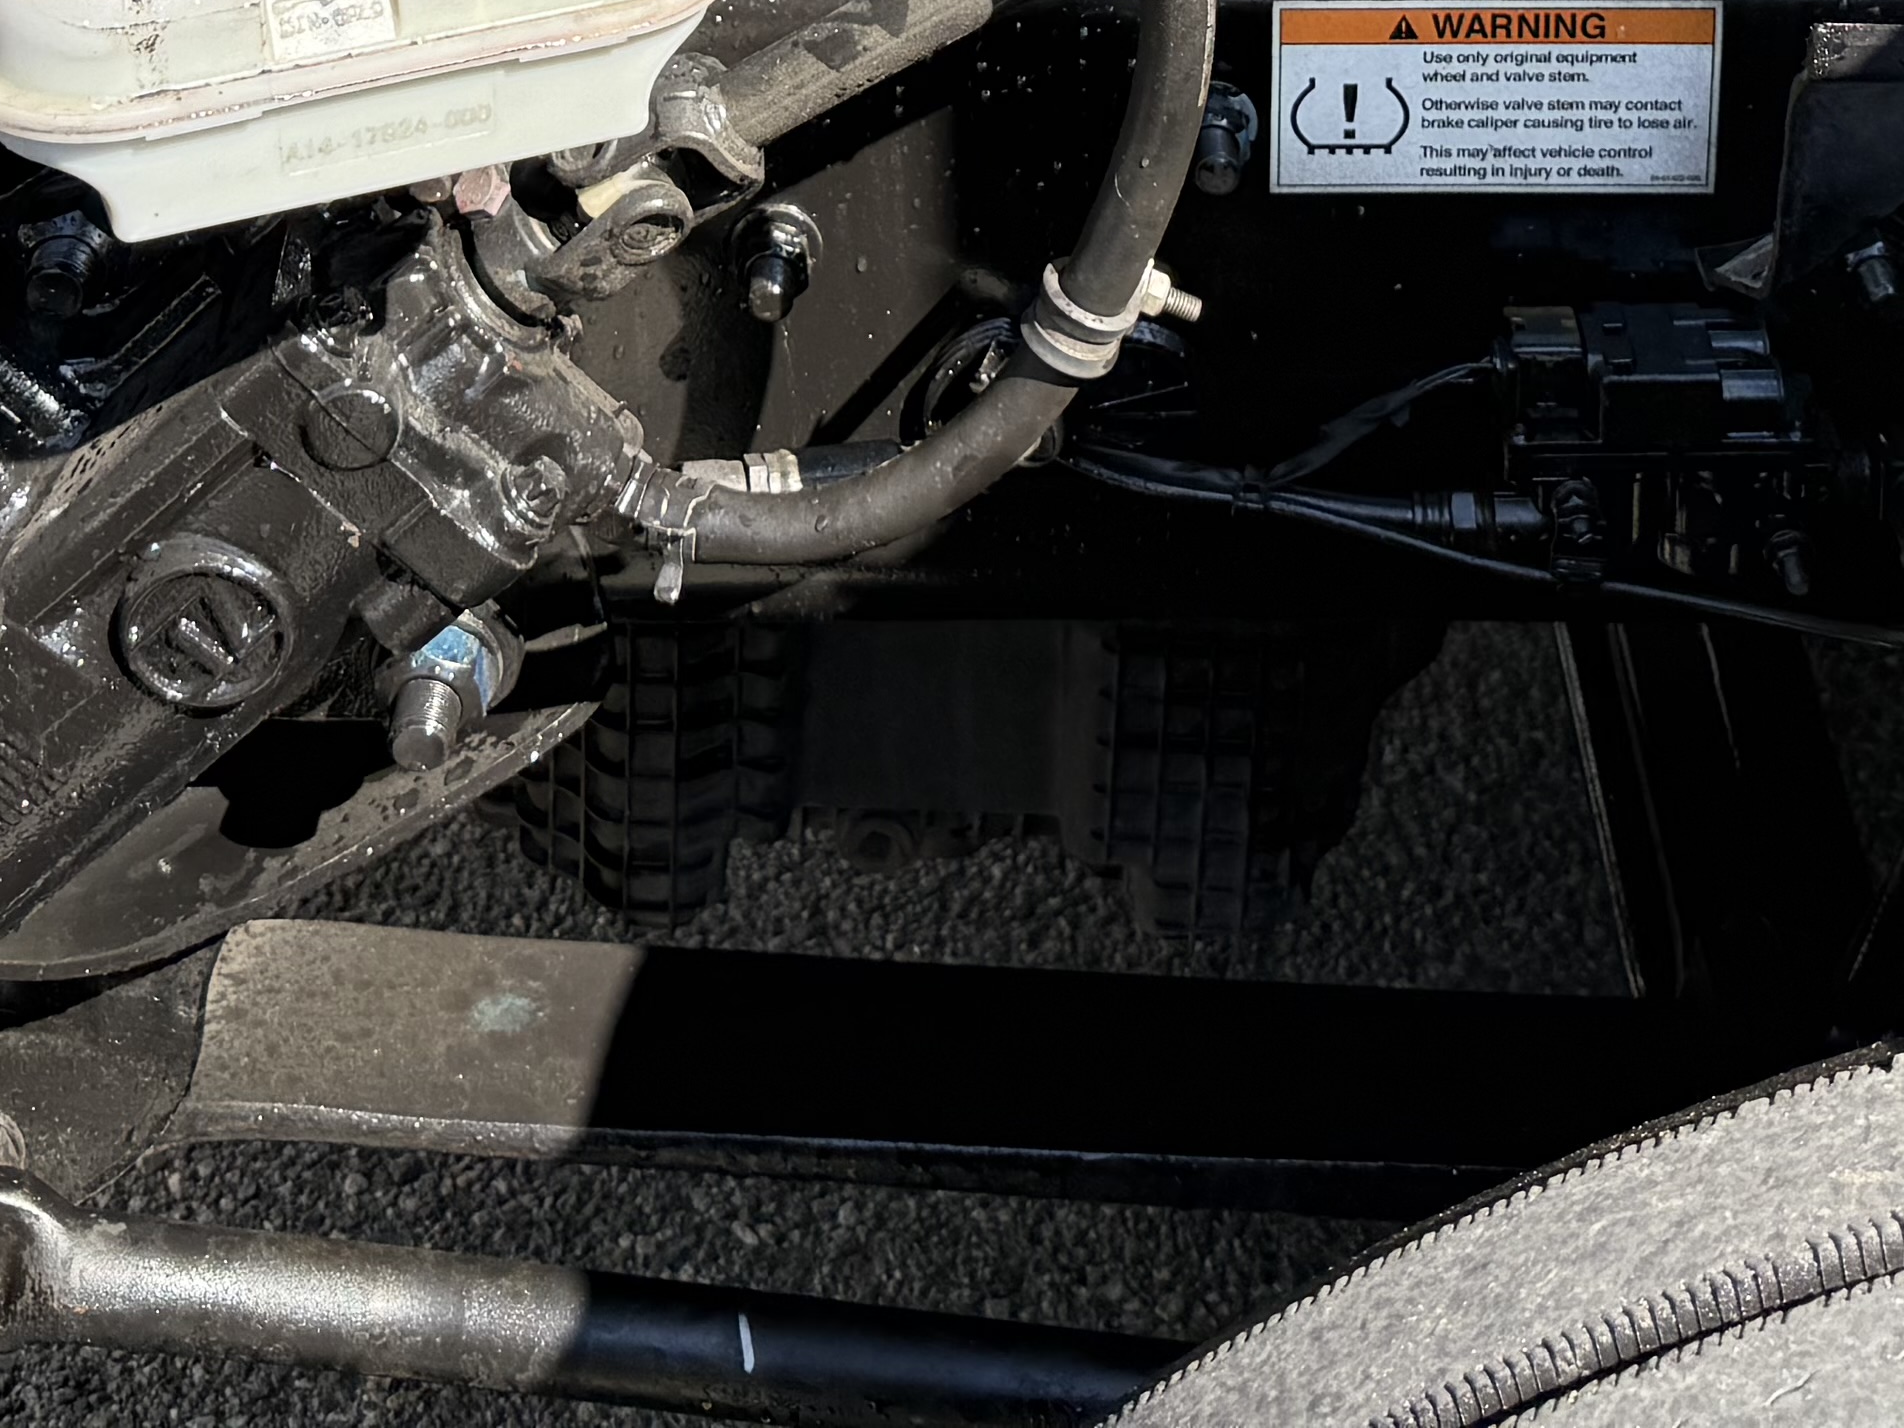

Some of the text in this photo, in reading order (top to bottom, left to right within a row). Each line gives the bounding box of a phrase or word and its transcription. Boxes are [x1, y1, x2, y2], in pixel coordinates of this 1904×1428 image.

[1432, 12, 1607, 40] WARNING
[1423, 50, 1637, 68] Use only original equipment
[1422, 69, 1590, 84] wheel and valve stem.
[1422, 98, 1683, 116] Otherwise valve stem may contact
[1421, 115, 1697, 132] brake caliper causing tire to lose air.
[1421, 144, 1653, 163] This may affect vehicle control
[1420, 164, 1623, 181] resulting in injury or death.
